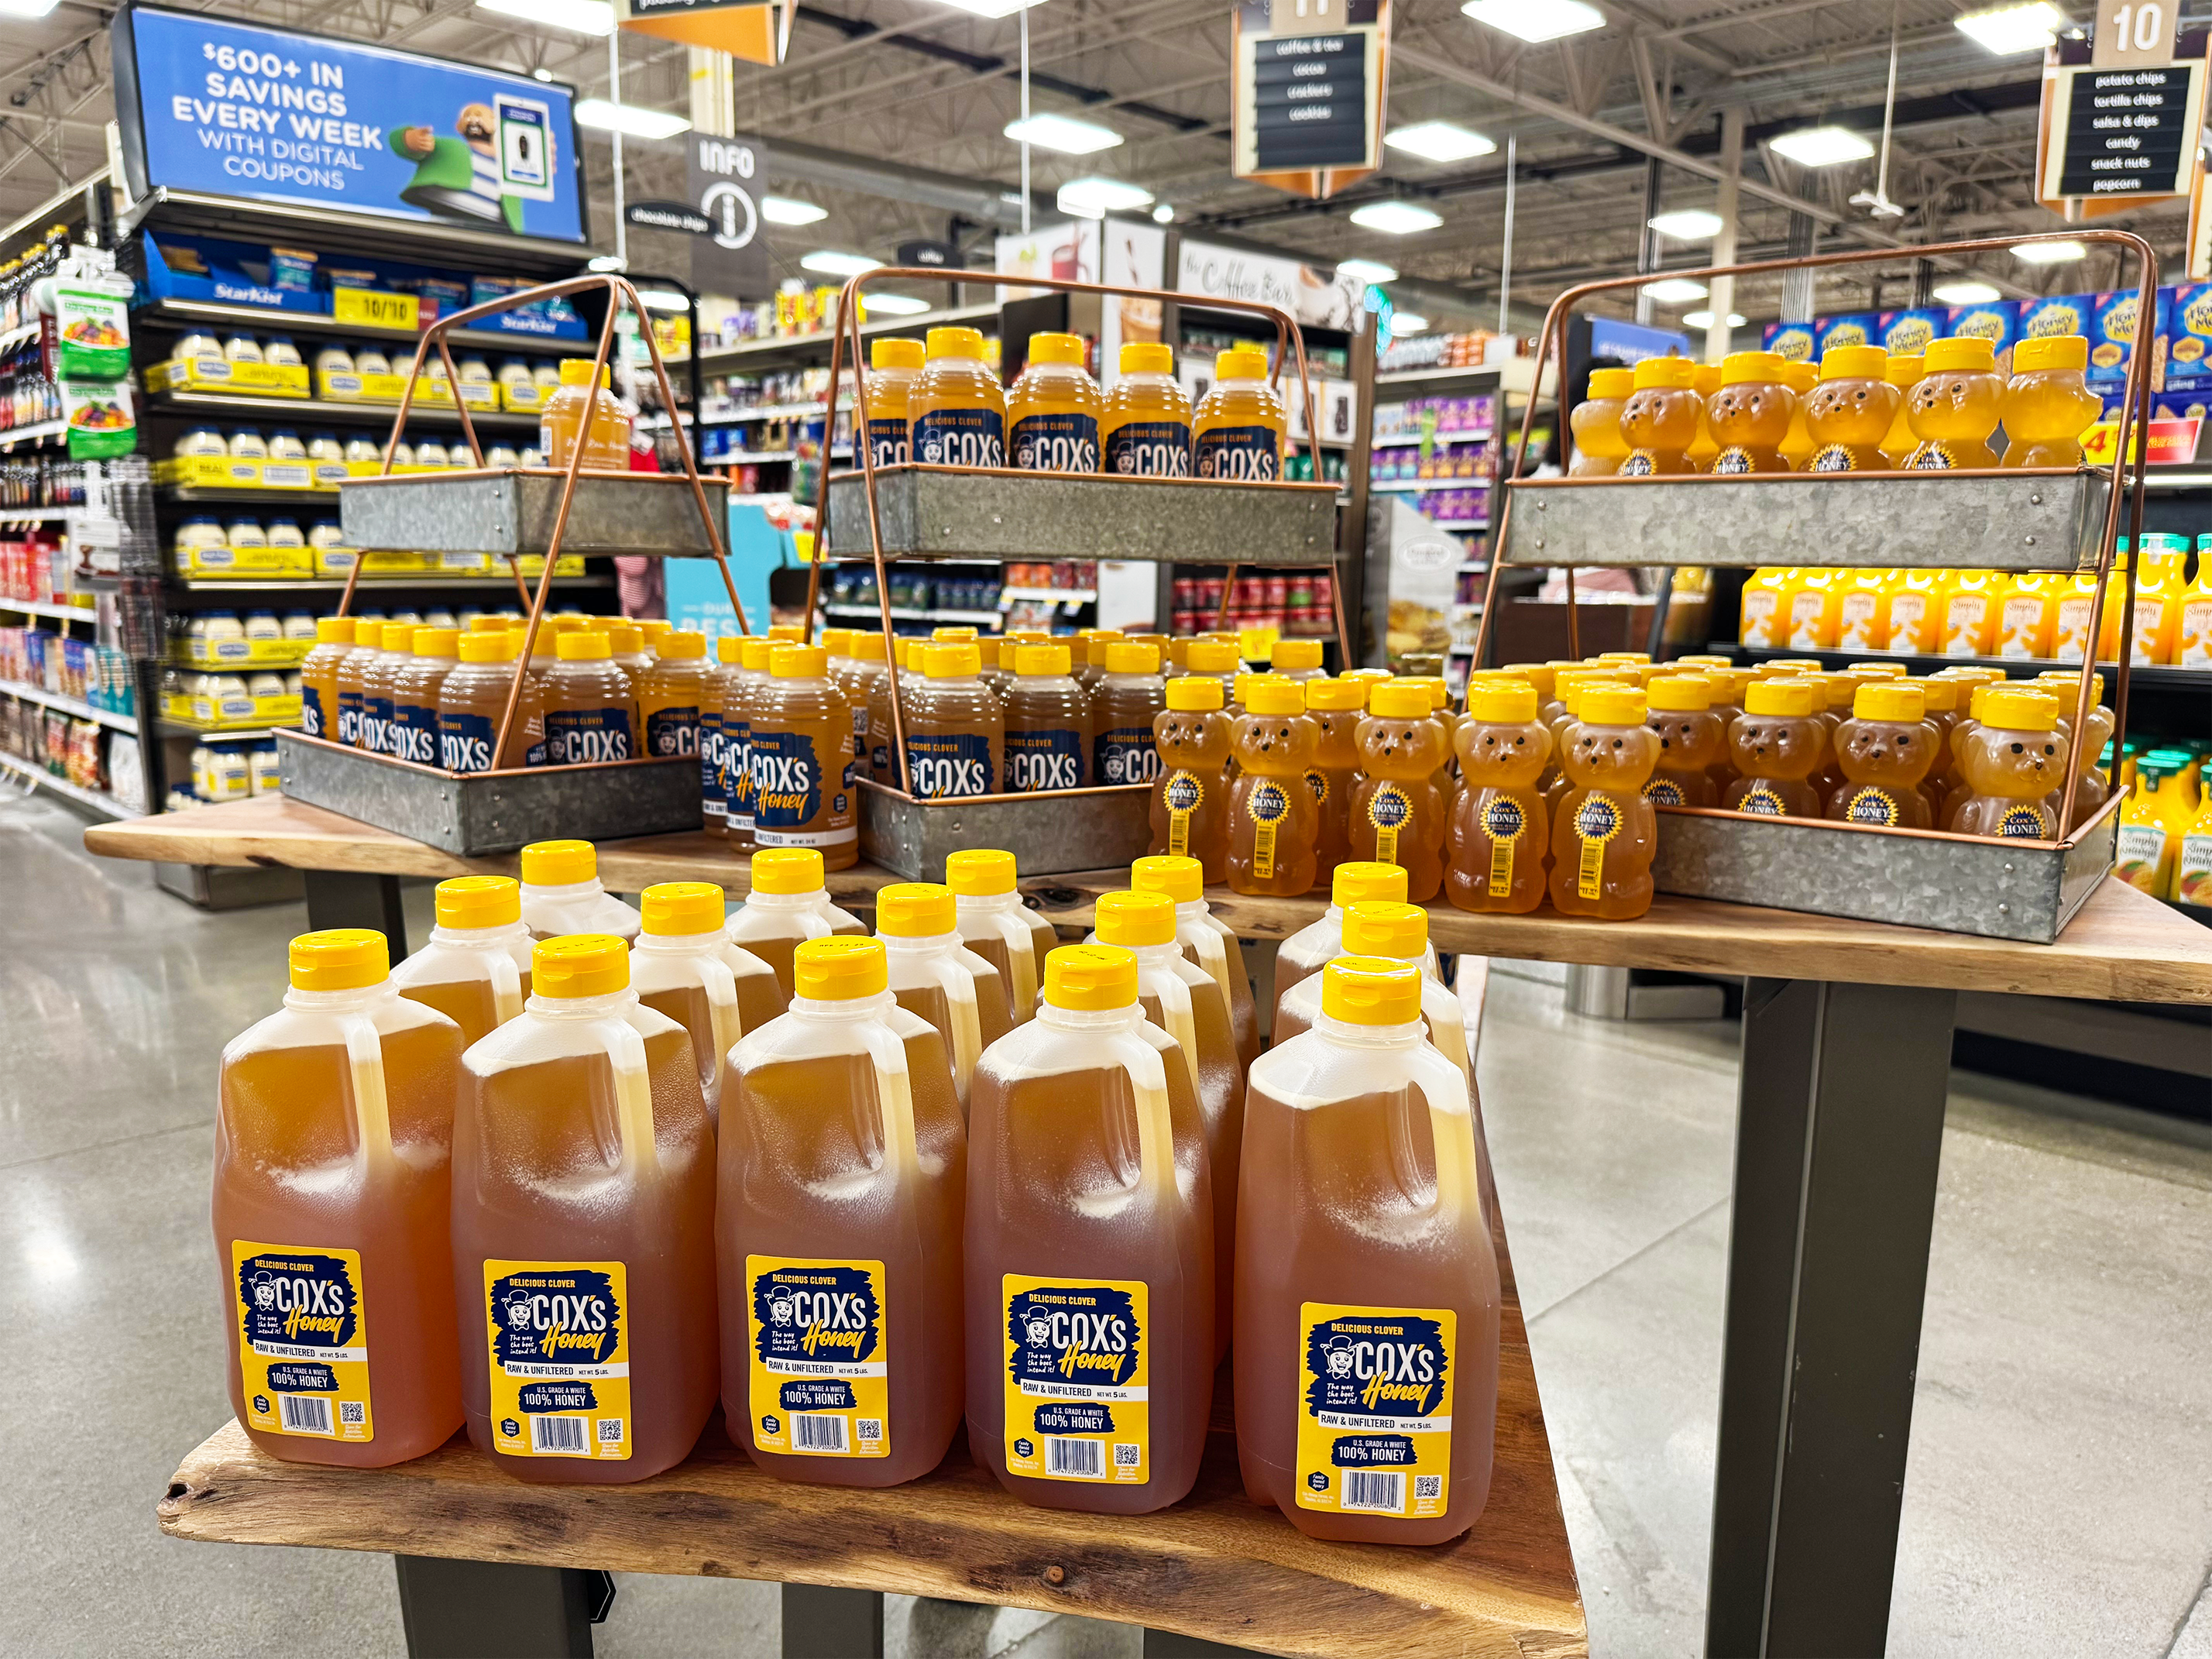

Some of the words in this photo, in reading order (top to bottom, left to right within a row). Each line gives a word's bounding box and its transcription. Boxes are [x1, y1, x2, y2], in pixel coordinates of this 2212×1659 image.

[2114, 3, 2162, 51] 10
[203, 43, 301, 78] $600+
[311, 61, 343, 89] IN
[2095, 74, 2135, 88] potato
[2135, 72, 2166, 86] chips
[206, 72, 347, 117] SAVINGS
[2094, 94, 2131, 108] tortilla
[2133, 93, 2163, 107] chips
[172, 95, 281, 134] EVERY
[289, 113, 383, 151] WEEK
[2093, 116, 2121, 129] salsa
[2122, 115, 2132, 128] &
[2134, 115, 2159, 129] dips
[198, 128, 264, 156] WITH
[272, 139, 364, 170] DIGITAL
[2106, 136, 2141, 150] candy
[699, 140, 754, 178] INFO
[2091, 156, 2123, 170] snack
[2124, 157, 2151, 168] nuts
[223, 156, 345, 191] COUPONS
[2093, 178, 2141, 192] popcorn
[215, 283, 283, 305] StarKist
[363, 298, 407, 321] 10/10
[501, 313, 557, 334] StarKist
[959, 417, 981, 426] CLOVER
[933, 743, 959, 752] CLOVER
[1028, 739, 1052, 747] CLOVER
[1169, 788, 1198, 799] HONEY
[758, 782, 809, 820] Honey
[1252, 798, 1285, 809] HONEY
[1373, 803, 1406, 814] HONEY
[1853, 808, 1891, 817] HONEY
[1487, 813, 1521, 824] HONEY
[1580, 813, 1616, 825] HONEY
[2004, 825, 2039, 834] HONEY
[255, 1259, 287, 1270] DELICIOUS
[290, 1262, 314, 1273] CLOVER
[510, 1279, 546, 1287] DELICIOUS
[548, 1279, 575, 1288] CLOVER
[772, 1274, 808, 1284] DELICIOUS
[810, 1276, 836, 1285] CLOVER
[1029, 1293, 1066, 1304] DELICIOUS
[1069, 1297, 1096, 1306] CLOVER
[283, 1304, 345, 1343] Honey
[1331, 1323, 1372, 1334] DELICIOUS
[1374, 1326, 1403, 1335] CLOVER
[540, 1321, 606, 1359] Honey
[801, 1319, 866, 1358] Honey
[256, 1343, 269, 1352] RAW
[276, 1346, 315, 1358] UNFILTERED
[768, 1361, 783, 1369] RAW
[792, 1364, 833, 1373] UNFILTERED
[1058, 1341, 1126, 1382] Honey
[507, 1364, 521, 1373] RAW
[531, 1367, 574, 1376] UNFILTERED
[272, 1372, 297, 1386] 100%
[300, 1375, 328, 1388] HONEY
[1023, 1382, 1039, 1392] RAW
[1048, 1386, 1091, 1396] UNFILTERED
[1360, 1371, 1433, 1413] Honey
[524, 1393, 551, 1406] 100%
[555, 1395, 586, 1406] HONEY
[785, 1391, 812, 1404] 100%
[815, 1393, 845, 1405] HONEY
[1040, 1413, 1068, 1427] 100%
[1072, 1416, 1103, 1429] HONEY
[1321, 1414, 1338, 1424] RAW
[1348, 1417, 1395, 1428] UNFILTERED
[1338, 1446, 1368, 1460] 100%
[1372, 1448, 1405, 1461] HONEY
